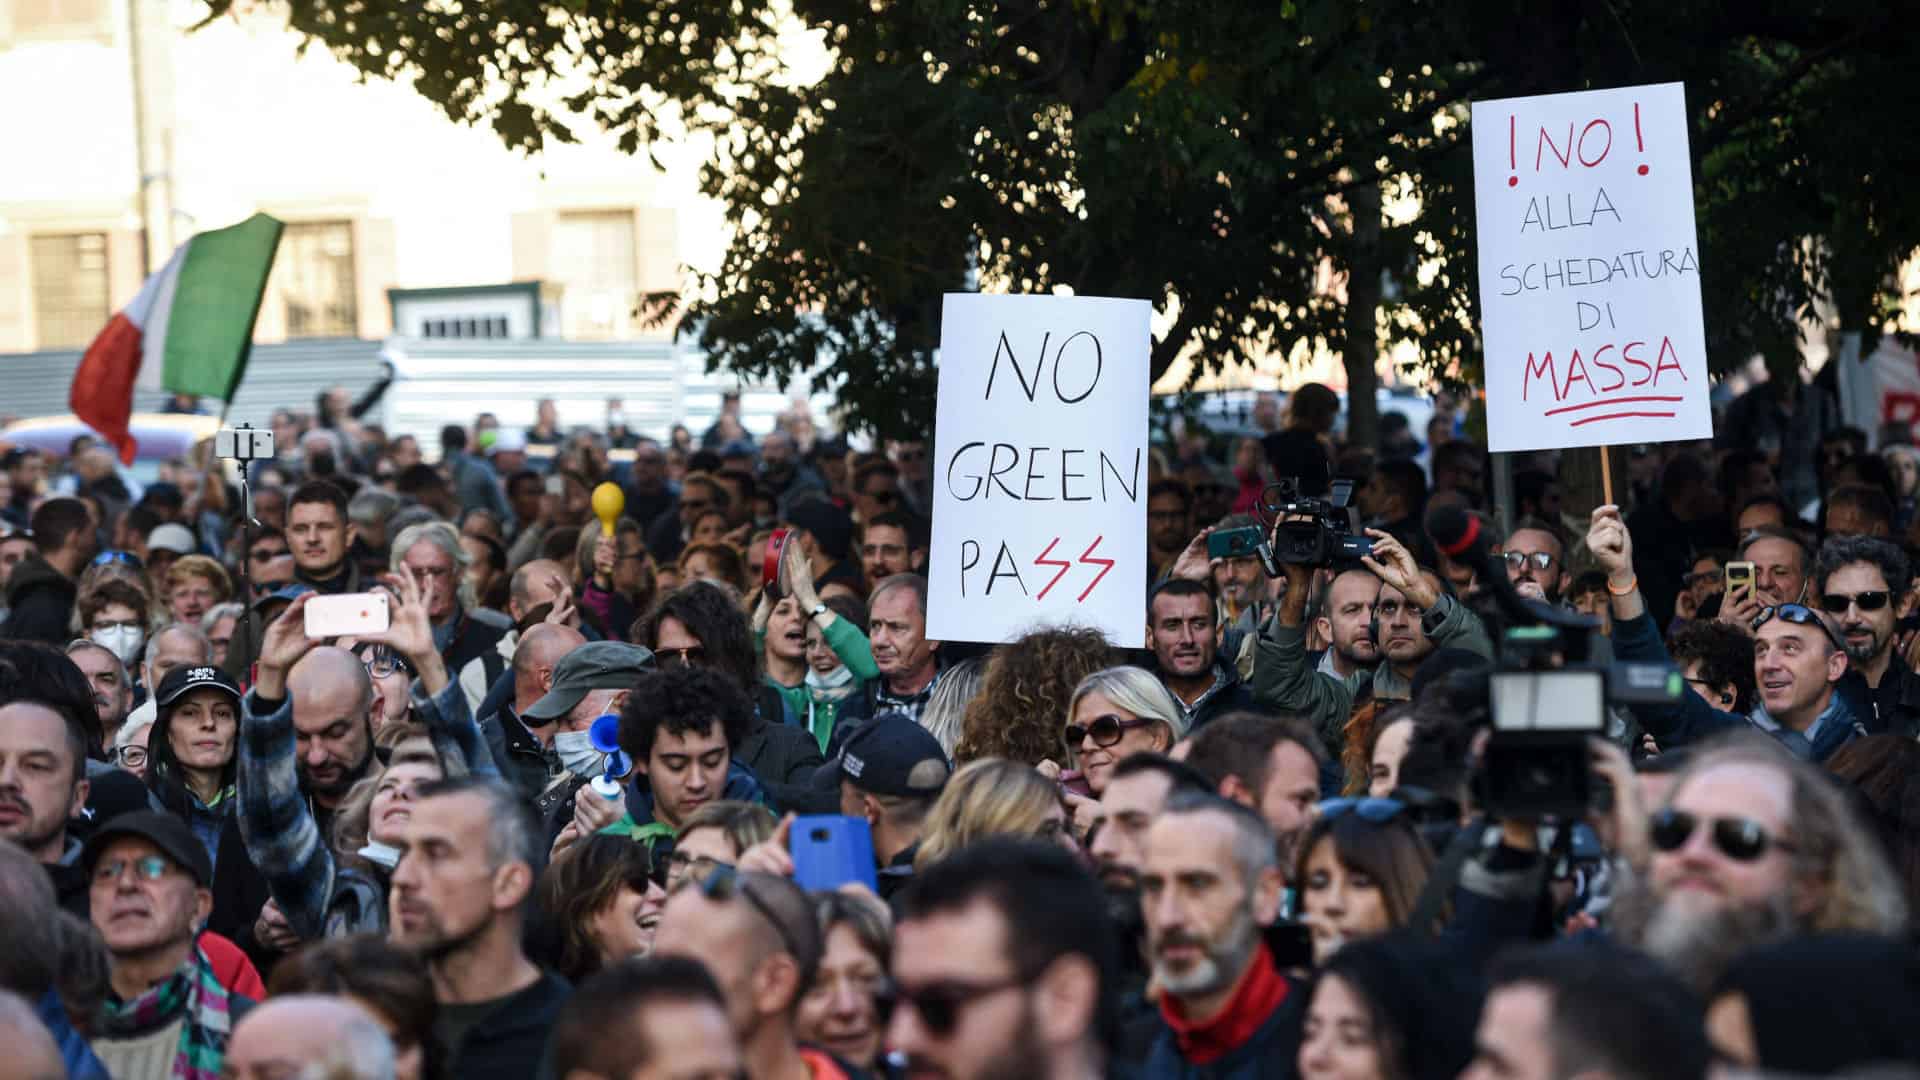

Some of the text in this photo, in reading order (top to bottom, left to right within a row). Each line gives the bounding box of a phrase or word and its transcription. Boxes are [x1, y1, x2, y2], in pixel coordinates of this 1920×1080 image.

[1520, 187, 1622, 233] ALLA
[1500, 247, 1700, 296] SCHEDATURA
[1576, 301, 1616, 332] DI
[984, 329, 1102, 404] NO
[1523, 335, 1688, 402] MASSA
[947, 441, 1140, 503] GREEN
[961, 535, 1115, 603] PASS
